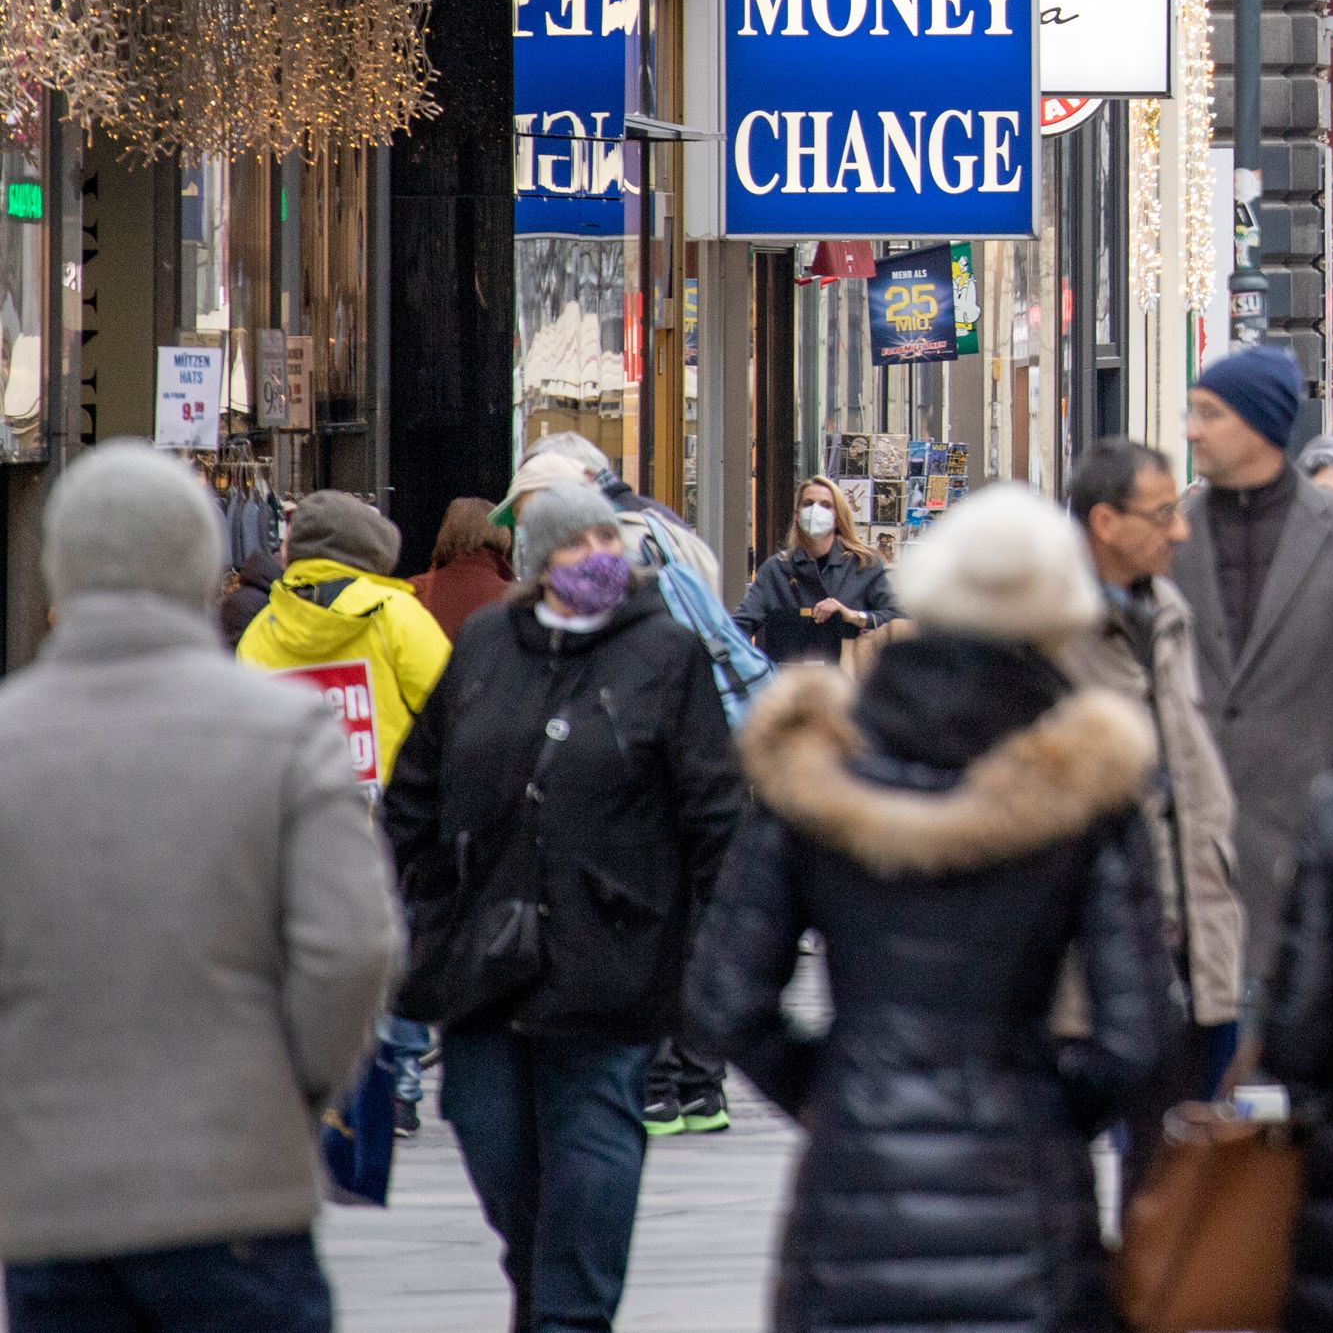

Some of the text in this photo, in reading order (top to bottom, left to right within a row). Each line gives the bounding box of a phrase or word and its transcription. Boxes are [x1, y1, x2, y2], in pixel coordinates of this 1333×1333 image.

[734, 109, 1022, 194] CHANGE
[891, 269, 928, 280] MEHR ALS
[884, 283, 939, 324] 25
[179, 371, 204, 385] HATS
